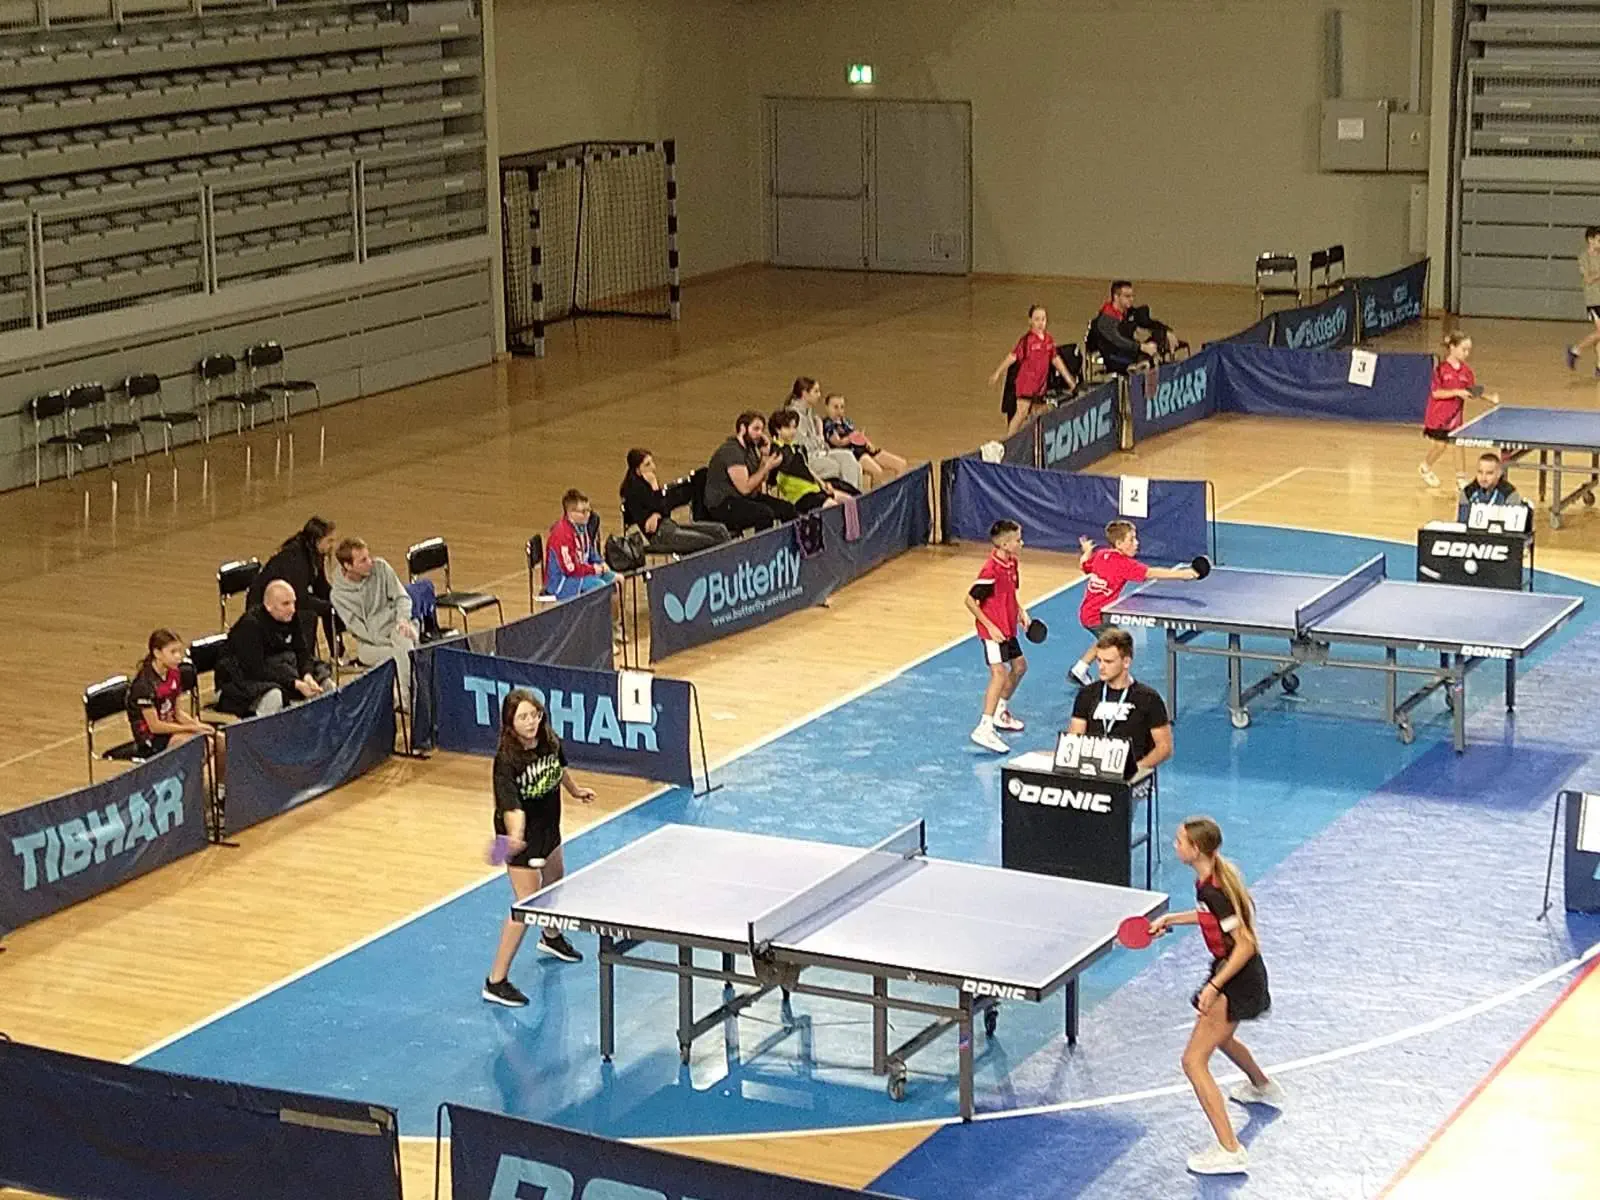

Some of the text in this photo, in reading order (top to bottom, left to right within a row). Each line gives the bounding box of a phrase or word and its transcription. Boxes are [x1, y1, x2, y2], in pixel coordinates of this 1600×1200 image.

[1358, 361, 1366, 373] 3
[1130, 489, 1139, 502] 2
[1476, 510, 1483, 526] 0
[1431, 540, 1508, 561] DONIC
[709, 547, 800, 612] Butterfly
[1110, 614, 1157, 628] DONIC
[1461, 645, 1513, 659] DONIC
[633, 689, 640, 705] 1
[1063, 743, 1074, 763] 3
[1107, 748, 1123, 769] 10
[1019, 784, 1112, 813] DONIC
[12, 777, 184, 891] TIBHAR
[524, 913, 581, 931] DONIC
[962, 979, 1027, 1000] DONIC
